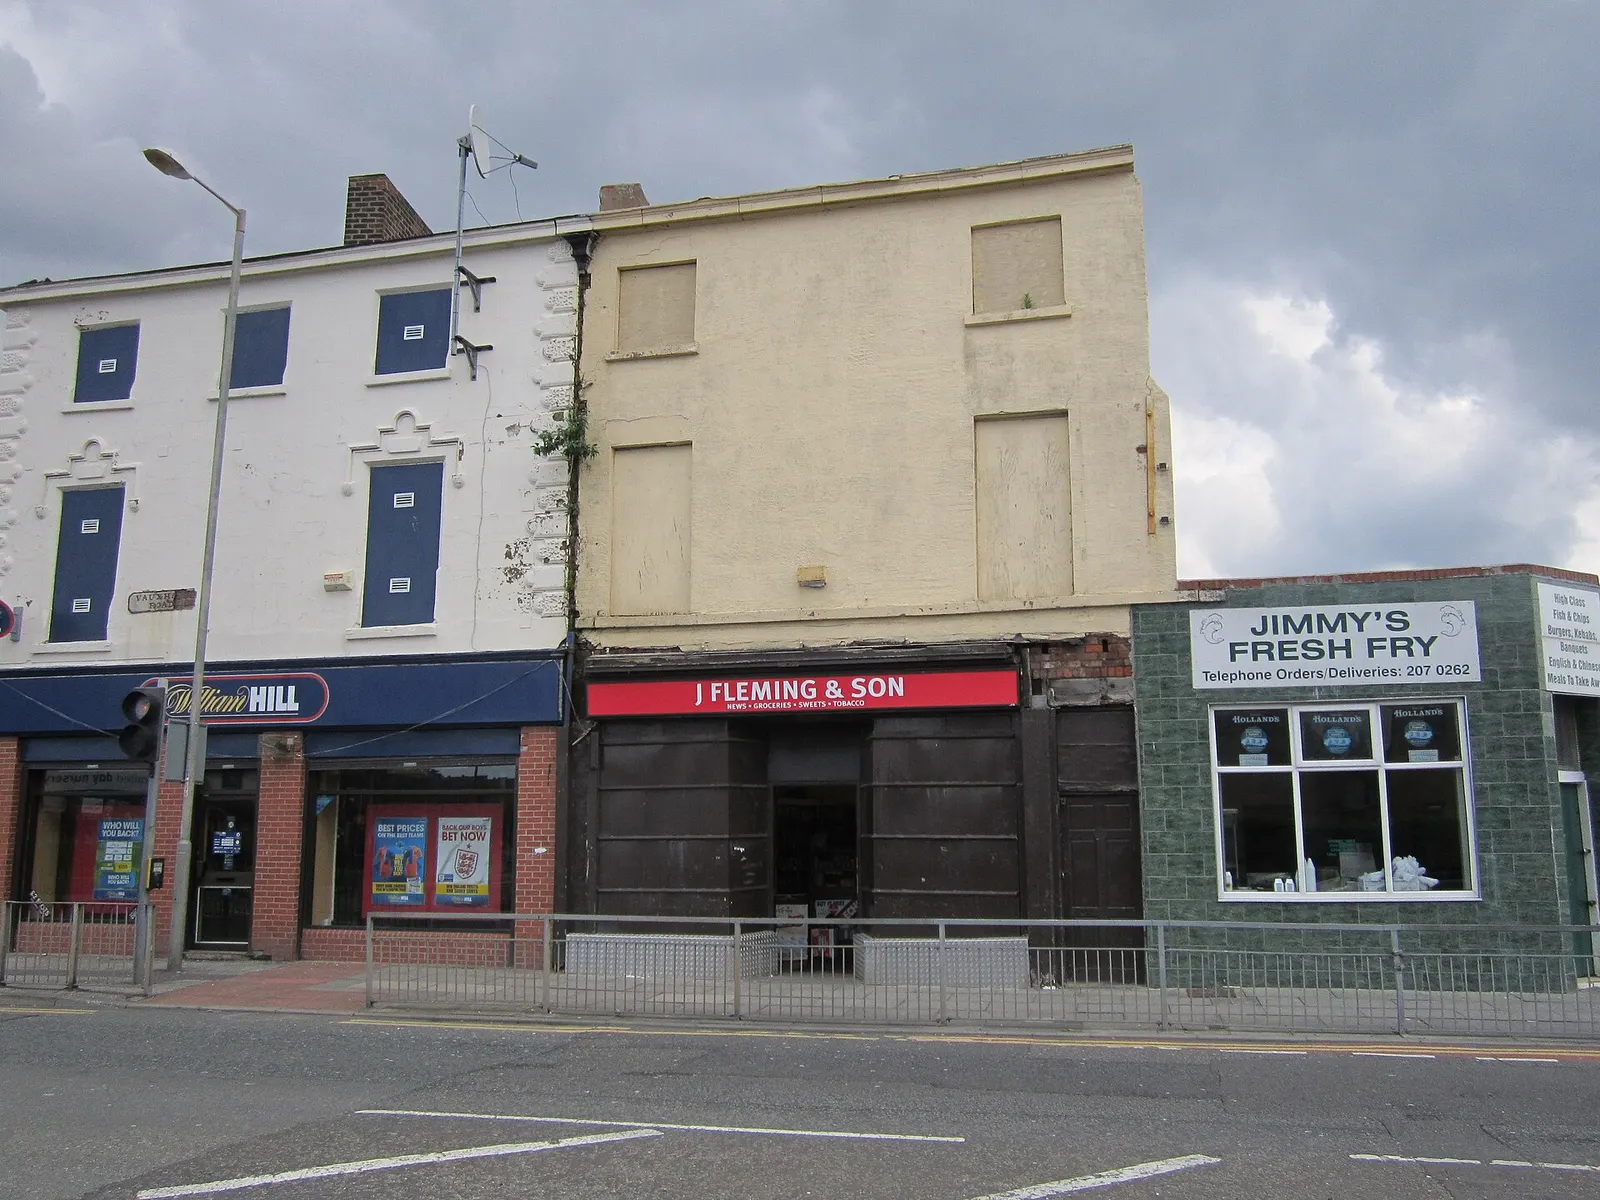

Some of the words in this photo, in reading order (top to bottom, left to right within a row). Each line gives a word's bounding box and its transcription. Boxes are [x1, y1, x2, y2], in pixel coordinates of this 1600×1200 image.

[1554, 593, 1568, 606] High
[1569, 595, 1586, 608] Class
[1250, 610, 1410, 636] JIMMY'S
[1553, 609, 1566, 621] Fish
[1567, 611, 1572, 621] &
[1573, 612, 1590, 625] Chips
[1229, 638, 1352, 662] FRESH
[1367, 636, 1438, 659] FRY
[1560, 642, 1588, 654] Banquets
[1549, 657, 1571, 669] English
[1572, 659, 1577, 669] &
[1202, 670, 1272, 683] Telephone
[1406, 665, 1431, 677] 207
[1436, 664, 1470, 675] 0262
[1547, 673, 1566, 685] Meals
[1567, 675, 1574, 685] To
[1576, 676, 1589, 687] Take
[166, 684, 250, 714] Wlliam
[249, 686, 299, 711] HILL
[695, 683, 702, 706] J
[711, 680, 817, 702] FLEMING
[825, 680, 844, 699] &
[851, 677, 904, 698] SON
[103, 821, 122, 830] WHO
[123, 821, 139, 830] WILL
[377, 824, 395, 832] BEST
[396, 824, 424, 832] PRICES
[442, 832, 458, 841] BET
[460, 832, 486, 841] NOW
